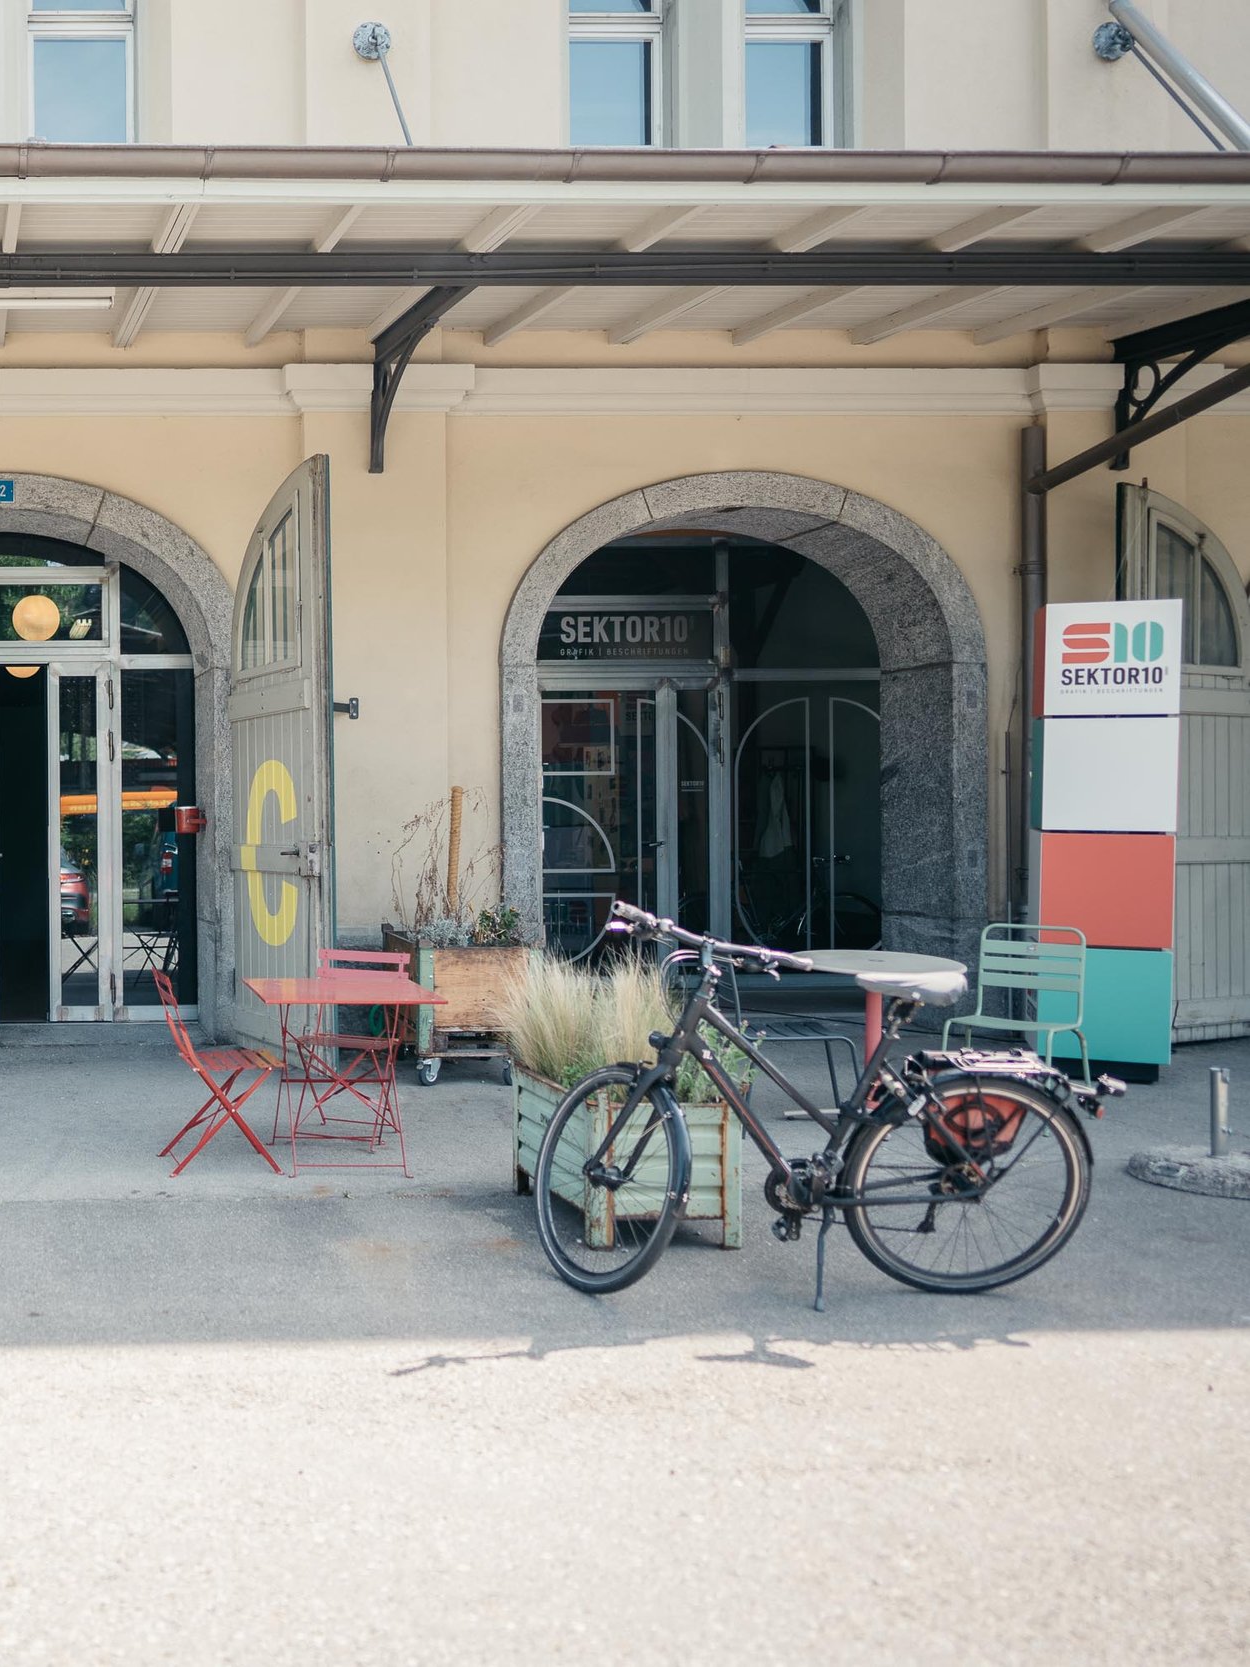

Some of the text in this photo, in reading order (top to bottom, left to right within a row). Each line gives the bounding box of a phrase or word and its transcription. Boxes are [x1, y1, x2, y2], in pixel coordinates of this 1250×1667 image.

[560, 615, 688, 644] SEKTOR10
[559, 647, 689, 656] GRAFIK BESCHRIFTUNGEN
[1061, 666, 1163, 686] SEKTOR10
[240, 759, 299, 947] C
